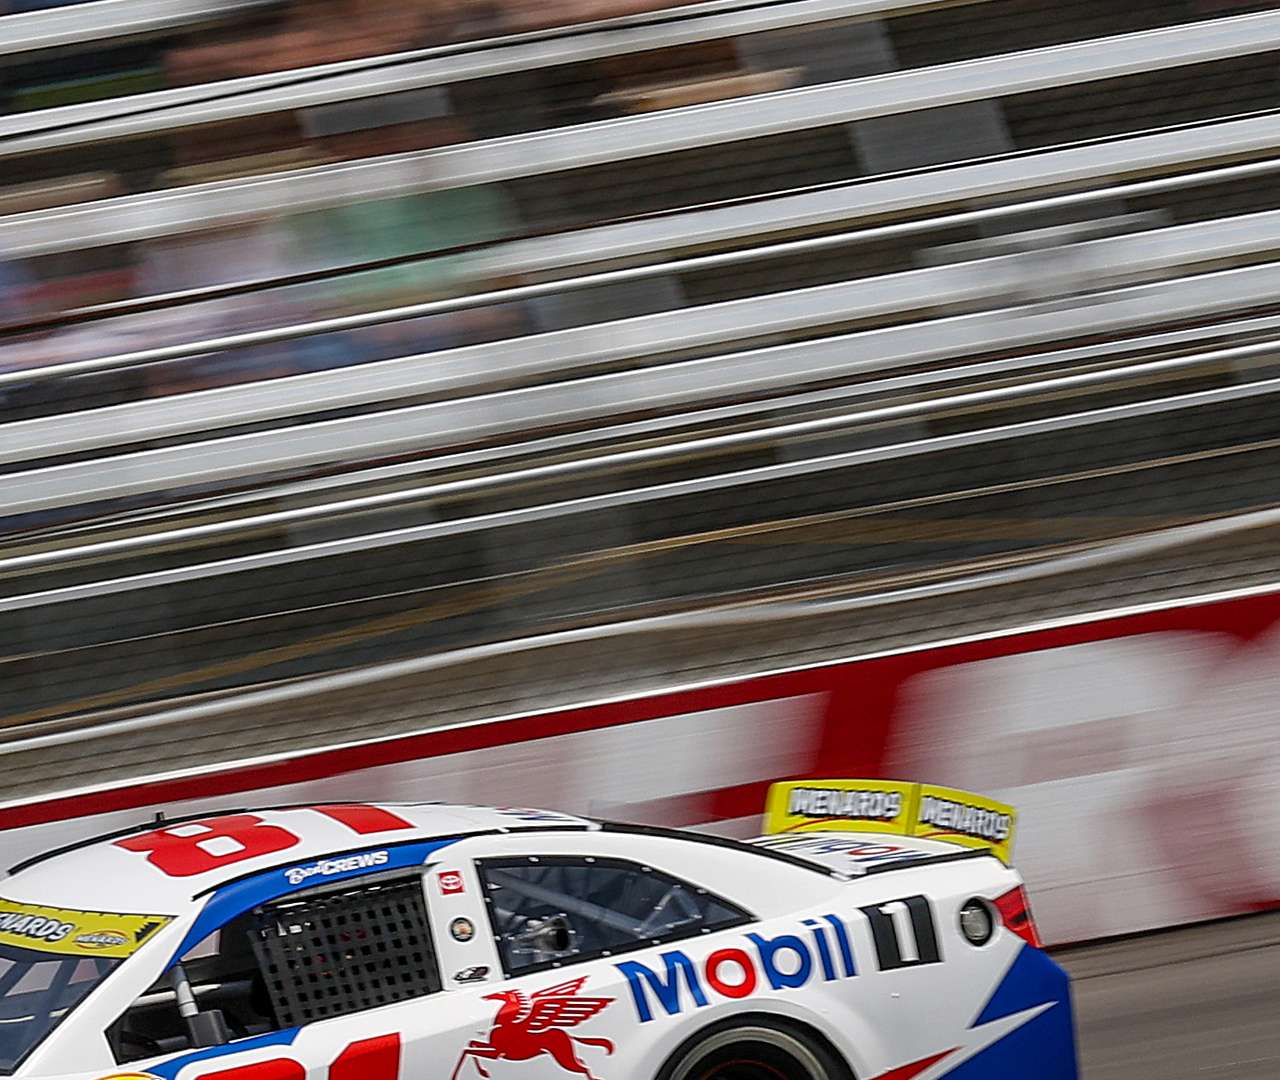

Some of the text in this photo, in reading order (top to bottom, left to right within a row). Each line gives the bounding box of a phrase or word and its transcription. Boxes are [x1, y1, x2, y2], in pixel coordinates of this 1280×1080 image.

[788, 788, 903, 819] MENARDS
[921, 796, 1011, 842] MENARDS
[114, 803, 418, 877] 81
[320, 850, 389, 875] CREWS
[616, 913, 858, 1023] Mobil
